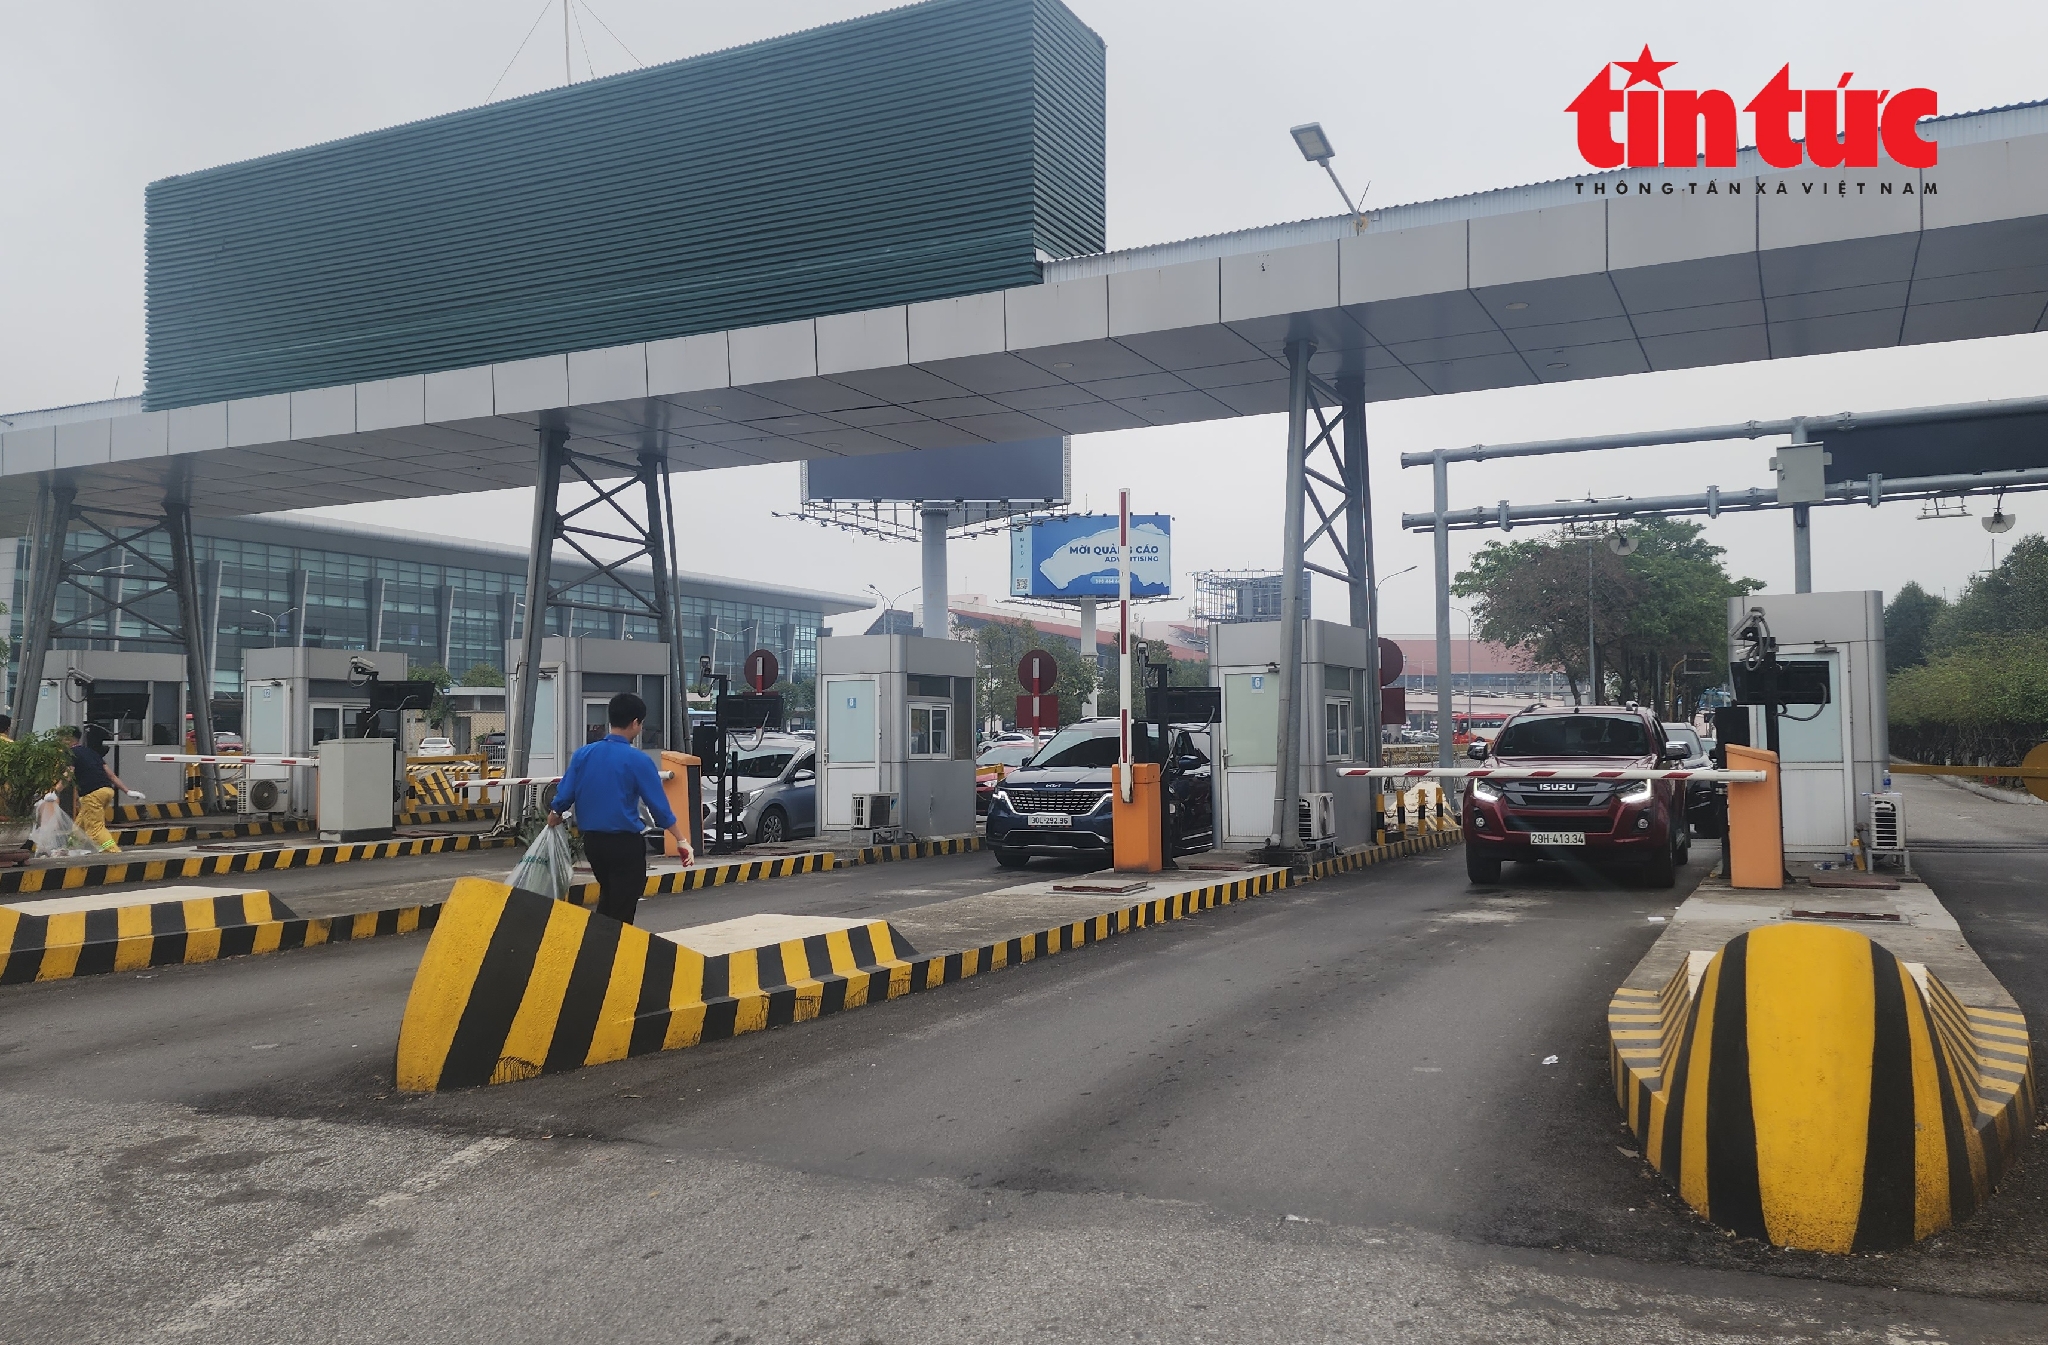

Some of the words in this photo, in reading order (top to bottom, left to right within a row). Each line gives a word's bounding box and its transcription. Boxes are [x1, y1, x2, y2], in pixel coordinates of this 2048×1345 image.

[1069, 544, 1091, 555] MỜI
[1093, 543, 1133, 555] QUẢ
[1135, 543, 1159, 554] CÁO
[1255, 677, 1261, 688] 6
[1539, 783, 1576, 791] ISUZU
[1531, 833, 1584, 844] 29H-413.34
